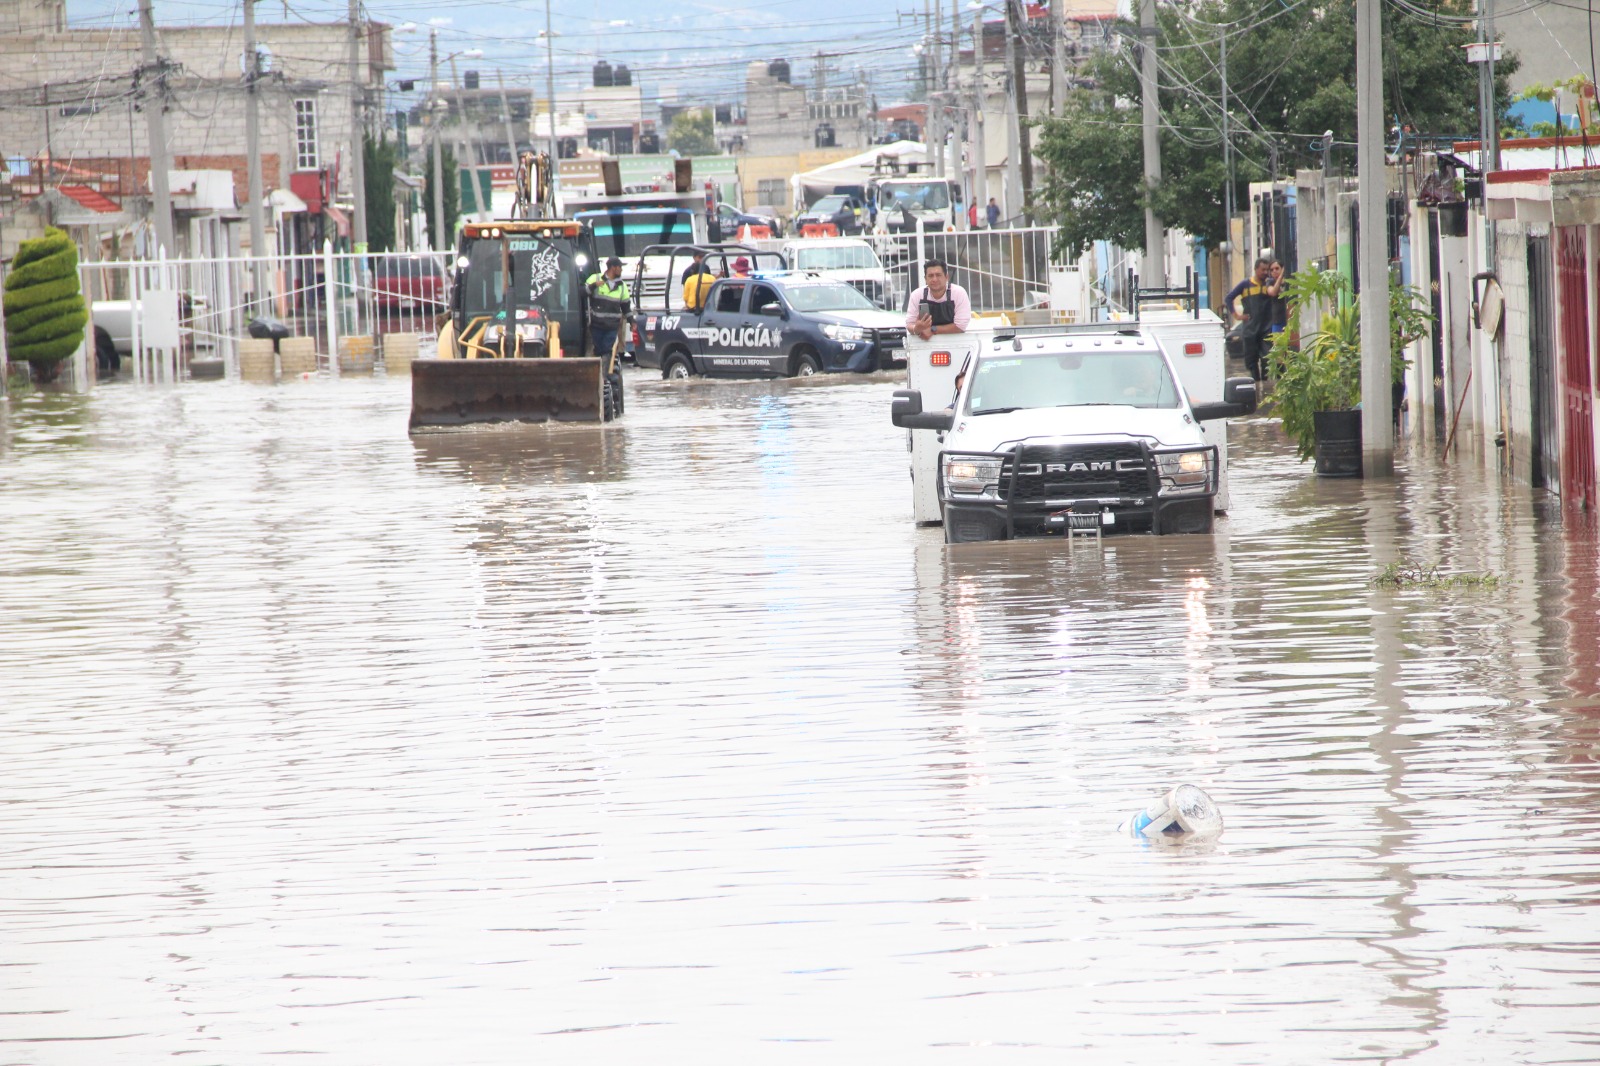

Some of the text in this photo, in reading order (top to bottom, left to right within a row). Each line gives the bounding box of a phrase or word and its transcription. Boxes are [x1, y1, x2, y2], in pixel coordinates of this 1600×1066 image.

[661, 315, 681, 331] 167
[708, 322, 771, 347] POLICÍA
[842, 342, 856, 351] 167
[713, 358, 733, 366] MINERAL
[734, 358, 740, 366] DE
[1046, 461, 1112, 473] RAM
